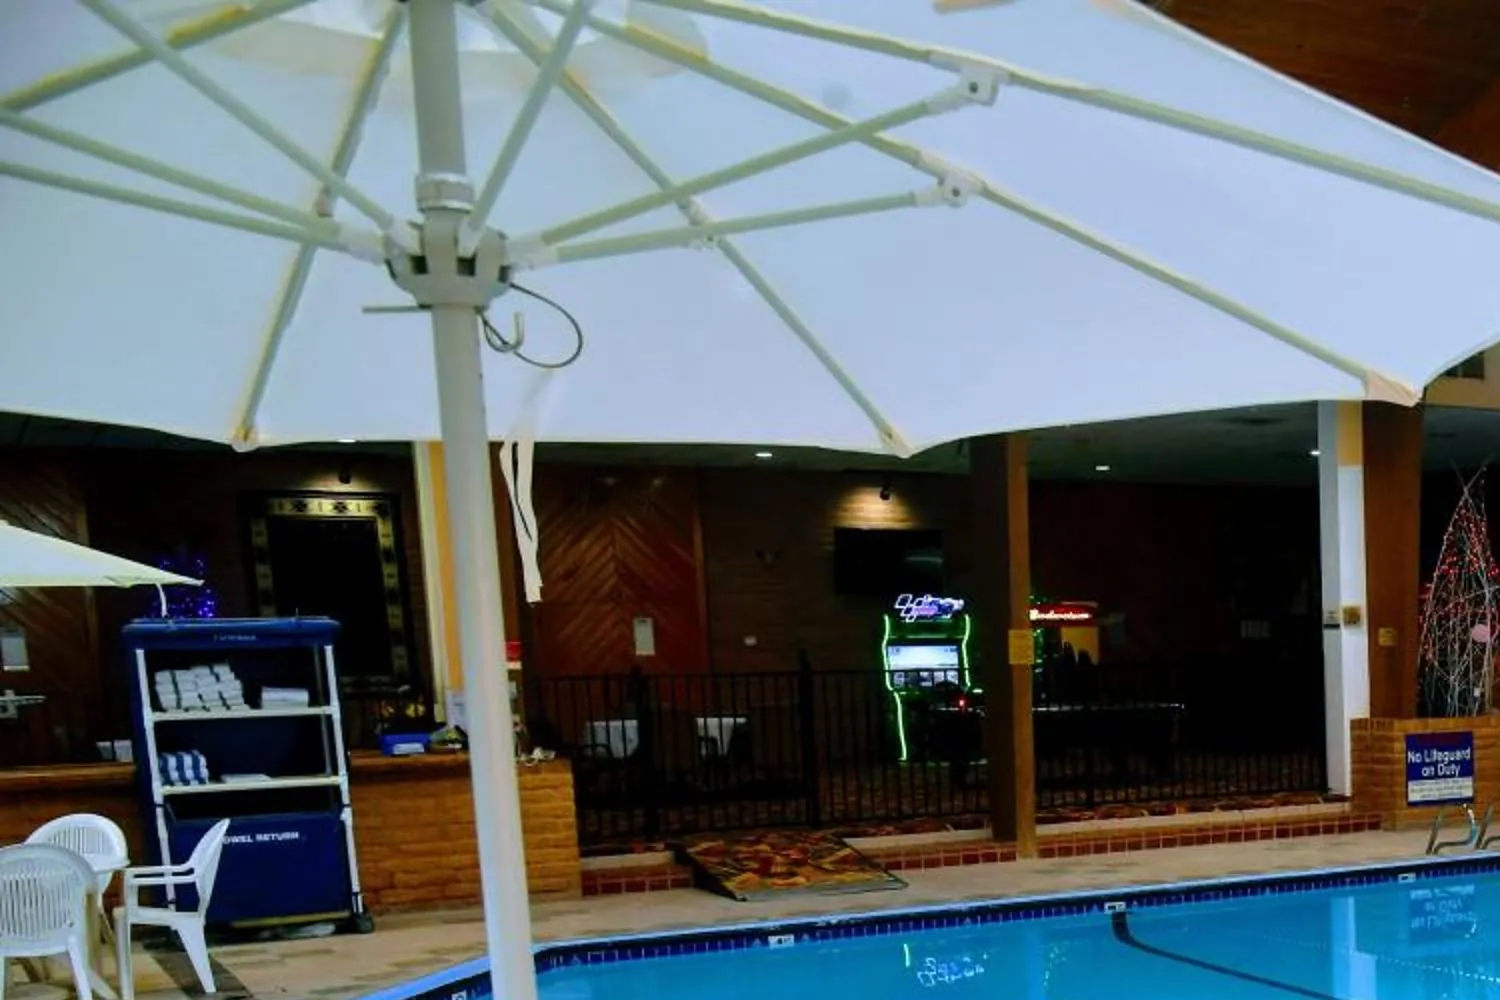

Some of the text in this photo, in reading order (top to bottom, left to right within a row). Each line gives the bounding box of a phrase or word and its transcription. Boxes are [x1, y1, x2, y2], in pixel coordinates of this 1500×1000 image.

[1408, 746, 1471, 765] No Lifeguard
[1421, 763, 1461, 778] on Duty
[222, 831, 299, 844] OWEL RETURN
